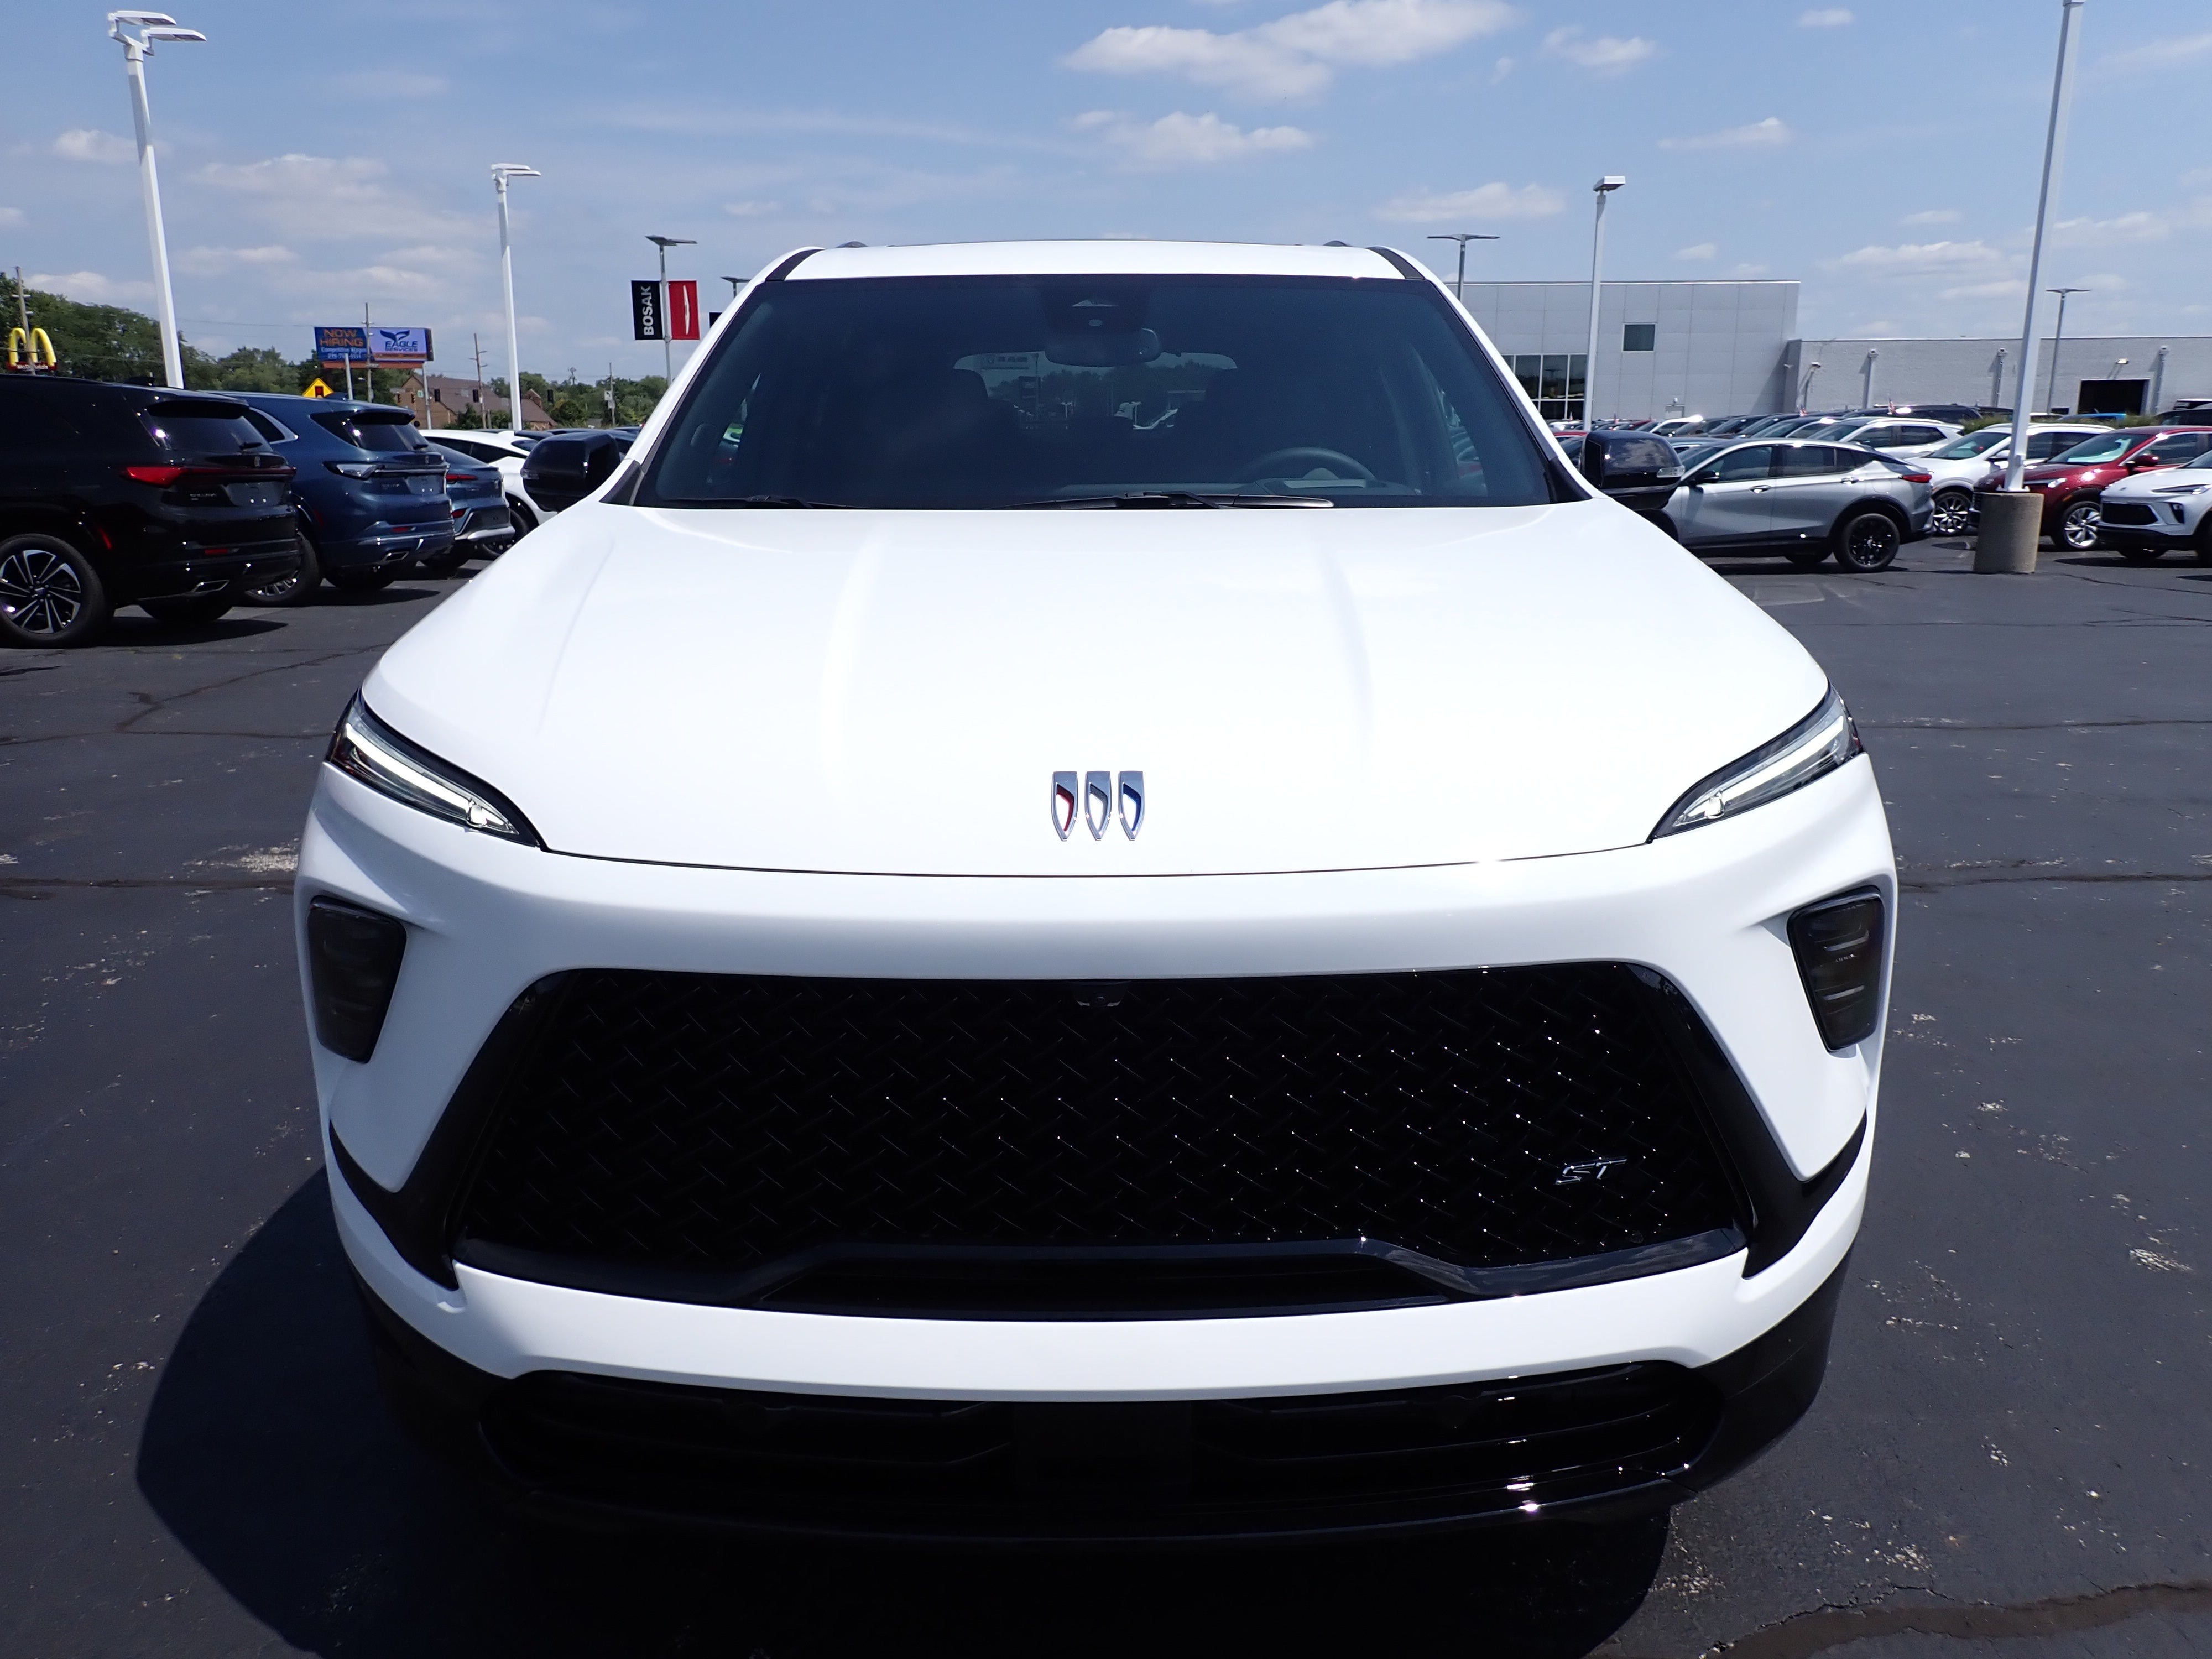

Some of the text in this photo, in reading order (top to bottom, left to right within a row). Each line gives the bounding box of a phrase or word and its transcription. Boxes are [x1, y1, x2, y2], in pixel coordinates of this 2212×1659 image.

[641, 285, 654, 335] BOSAK
[320, 337, 364, 347] HIRING
[324, 328, 357, 338] NOW
[1553, 1156, 1627, 1186] ST
